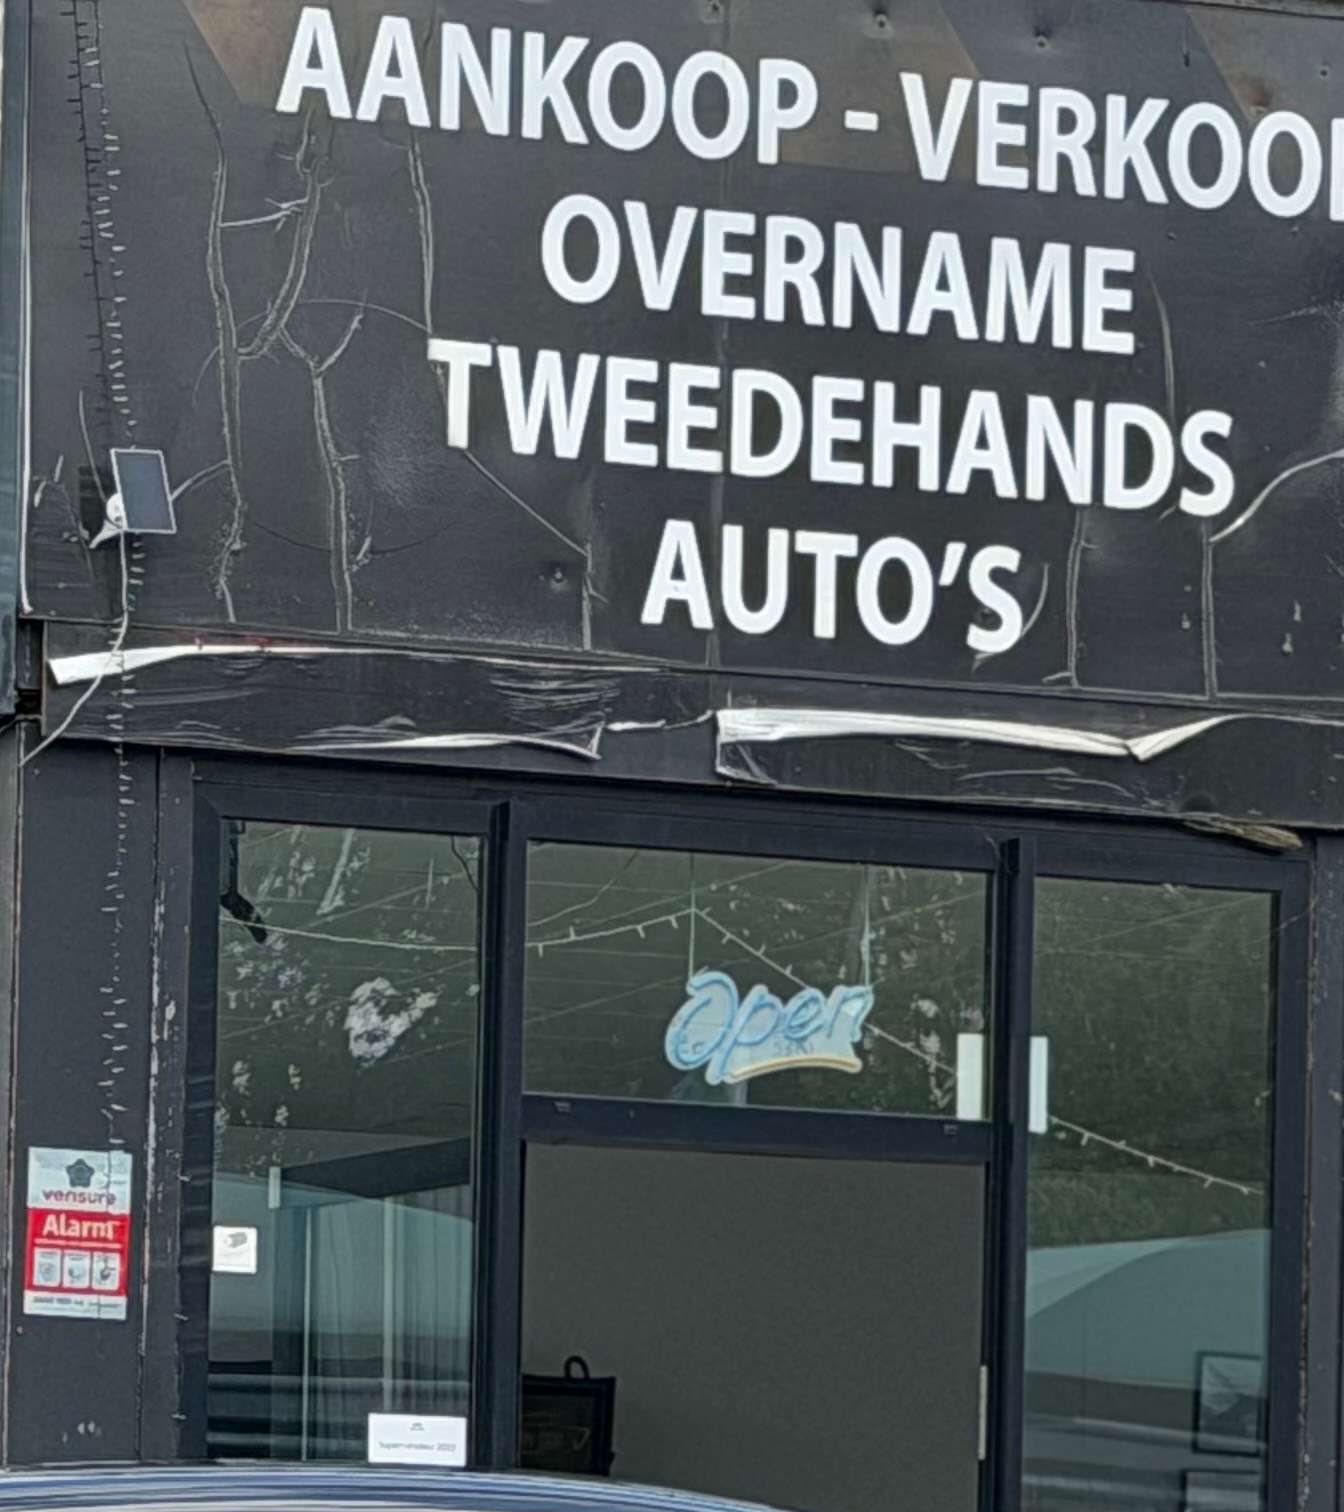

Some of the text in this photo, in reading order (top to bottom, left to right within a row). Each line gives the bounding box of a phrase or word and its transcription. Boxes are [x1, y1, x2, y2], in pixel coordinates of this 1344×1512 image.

[275, 6, 818, 165] AANKOOP
[541, 194, 1137, 355] OVERNAME
[427, 338, 1234, 518] TWEEDEHANDS
[640, 519, 1022, 654] AUTO'S
[668, 974, 871, 1080] Open
[43, 1213, 116, 1240] Alarm
